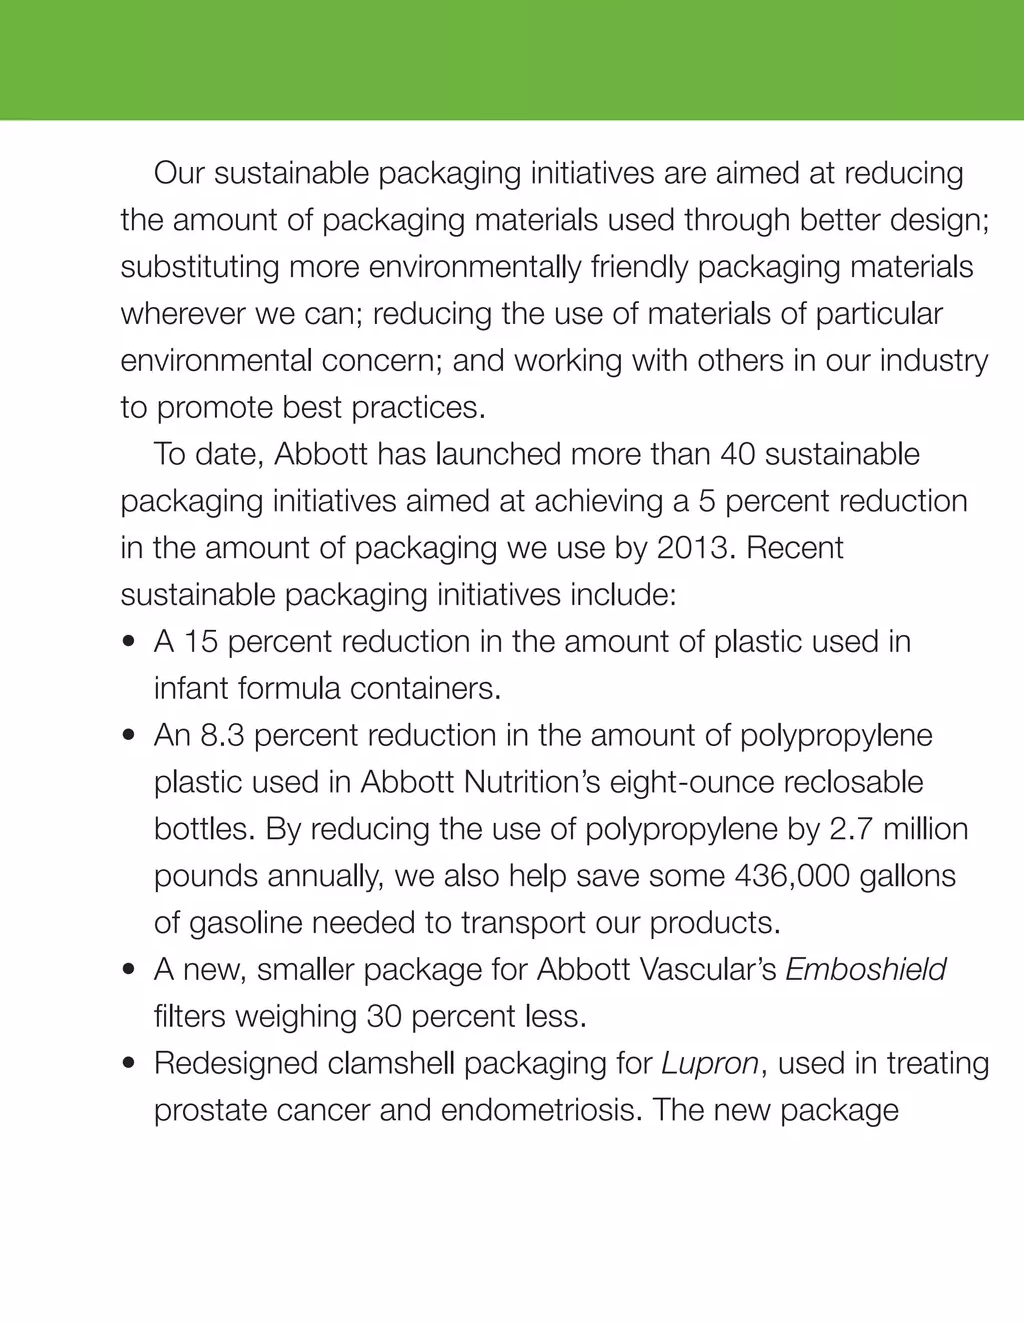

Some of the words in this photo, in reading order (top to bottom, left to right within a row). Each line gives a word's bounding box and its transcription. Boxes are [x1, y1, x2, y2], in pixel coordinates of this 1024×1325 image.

[154, 159, 206, 185] Our
[214, 159, 370, 185] sustainable
[379, 159, 521, 191] packaging
[531, 159, 655, 185] initiatives
[664, 165, 707, 185] are
[716, 159, 800, 185] aimed
[809, 161, 836, 185] at
[845, 159, 963, 191] reducing
[153, 440, 186, 466] To
[195, 440, 263, 470] date,
[273, 440, 368, 466] Abbott
[378, 440, 427, 466] has
[436, 440, 561, 466] launched
[571, 446, 642, 466] more
[649, 440, 711, 466] than
[720, 441, 756, 466] 40
[765, 440, 921, 466] sustainable
[153, 628, 175, 653] A
[185, 628, 218, 654] 15
[228, 629, 333, 659] percent
[342, 628, 470, 654] reduction
[480, 628, 502, 653] in
[511, 628, 556, 654] the
[564, 629, 670, 654] amount
[679, 628, 706, 654] of
[715, 628, 803, 659] plastic
[812, 628, 879, 654] used
[889, 628, 911, 653] in
[155, 768, 243, 800] plastic
[252, 768, 319, 794] used
[329, 768, 351, 794] in
[360, 768, 455, 794] Abbott
[610, 768, 775, 800] eight-ounce
[784, 768, 924, 794] reclosable
[153, 956, 175, 981] A
[184, 962, 246, 985] new,
[257, 955, 356, 982] smaller
[364, 956, 483, 988] package
[491, 956, 529, 982] for
[536, 956, 631, 982] Abbott
[785, 956, 948, 982] Emboshield
